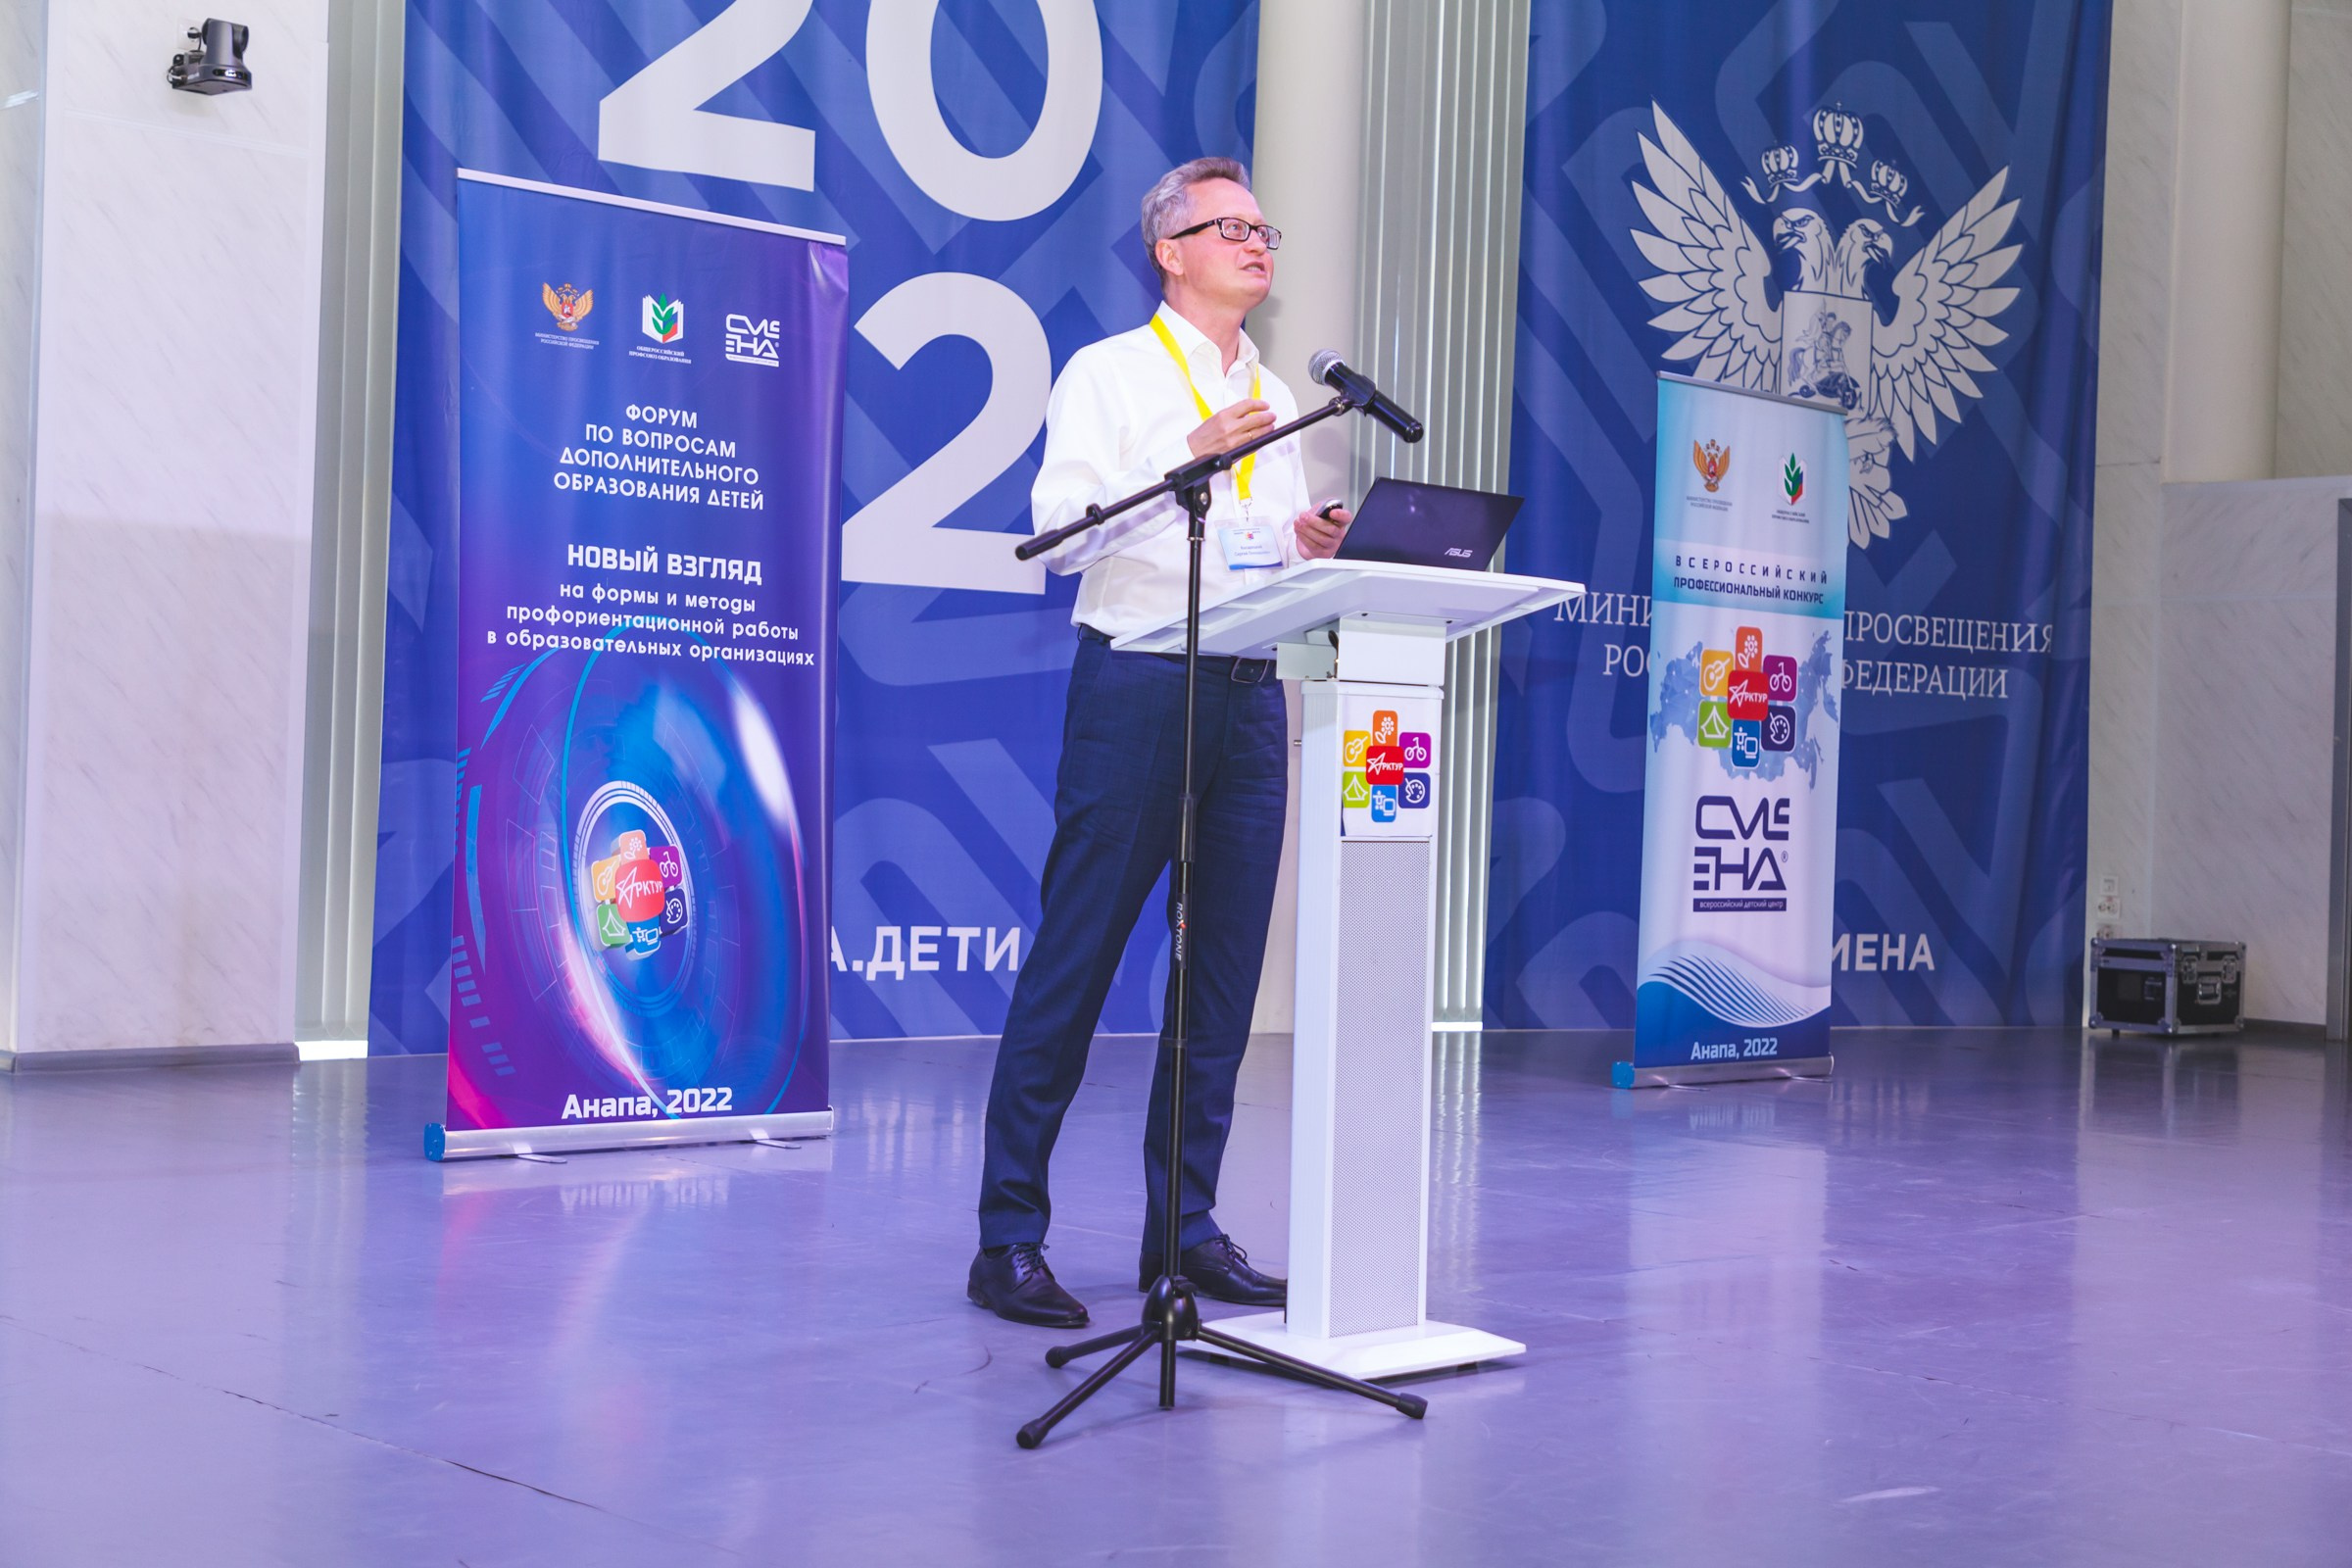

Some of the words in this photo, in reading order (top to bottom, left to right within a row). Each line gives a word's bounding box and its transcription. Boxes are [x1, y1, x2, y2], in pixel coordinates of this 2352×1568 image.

[625, 404, 698, 428] ФОРУМ
[842, 271, 1053, 595] 2
[585, 423, 613, 443] ПО
[622, 428, 736, 458] ВОПРОСАМ
[560, 447, 759, 485] ДОПОЛНИТЕЛЬНОГО
[554, 471, 700, 504] ОБРАЗОВАНИЯ
[707, 489, 764, 511] ДЕТЕЙ
[567, 544, 658, 573] НОВЫЙ
[667, 553, 762, 586] ВЗГЛЯД
[1444, 547, 1473, 558] ASUS
[1675, 555, 1828, 585] ВСЕРОССИЙСКИЙ
[560, 583, 584, 599] на
[592, 583, 659, 605] формы
[666, 592, 677, 606] и
[685, 592, 756, 614] методы
[1673, 576, 1781, 599] ПРОФЕССИОНАЛЬНЫЙ
[1783, 589, 1824, 605] КОНКУРС
[507, 605, 724, 635] профориентационной
[732, 620, 799, 640] работы
[487, 630, 497, 644] в
[506, 629, 682, 657] образовательных
[689, 644, 815, 666] организациях
[1602, 643, 1651, 677] РО
[1175, 902, 1184, 961] ROXTONE
[1690, 1042, 1740, 1059] Анапа,
[1742, 1037, 1778, 1056] 2022
[561, 1094, 659, 1119] Анапа,
[665, 1087, 733, 1113] 2022
